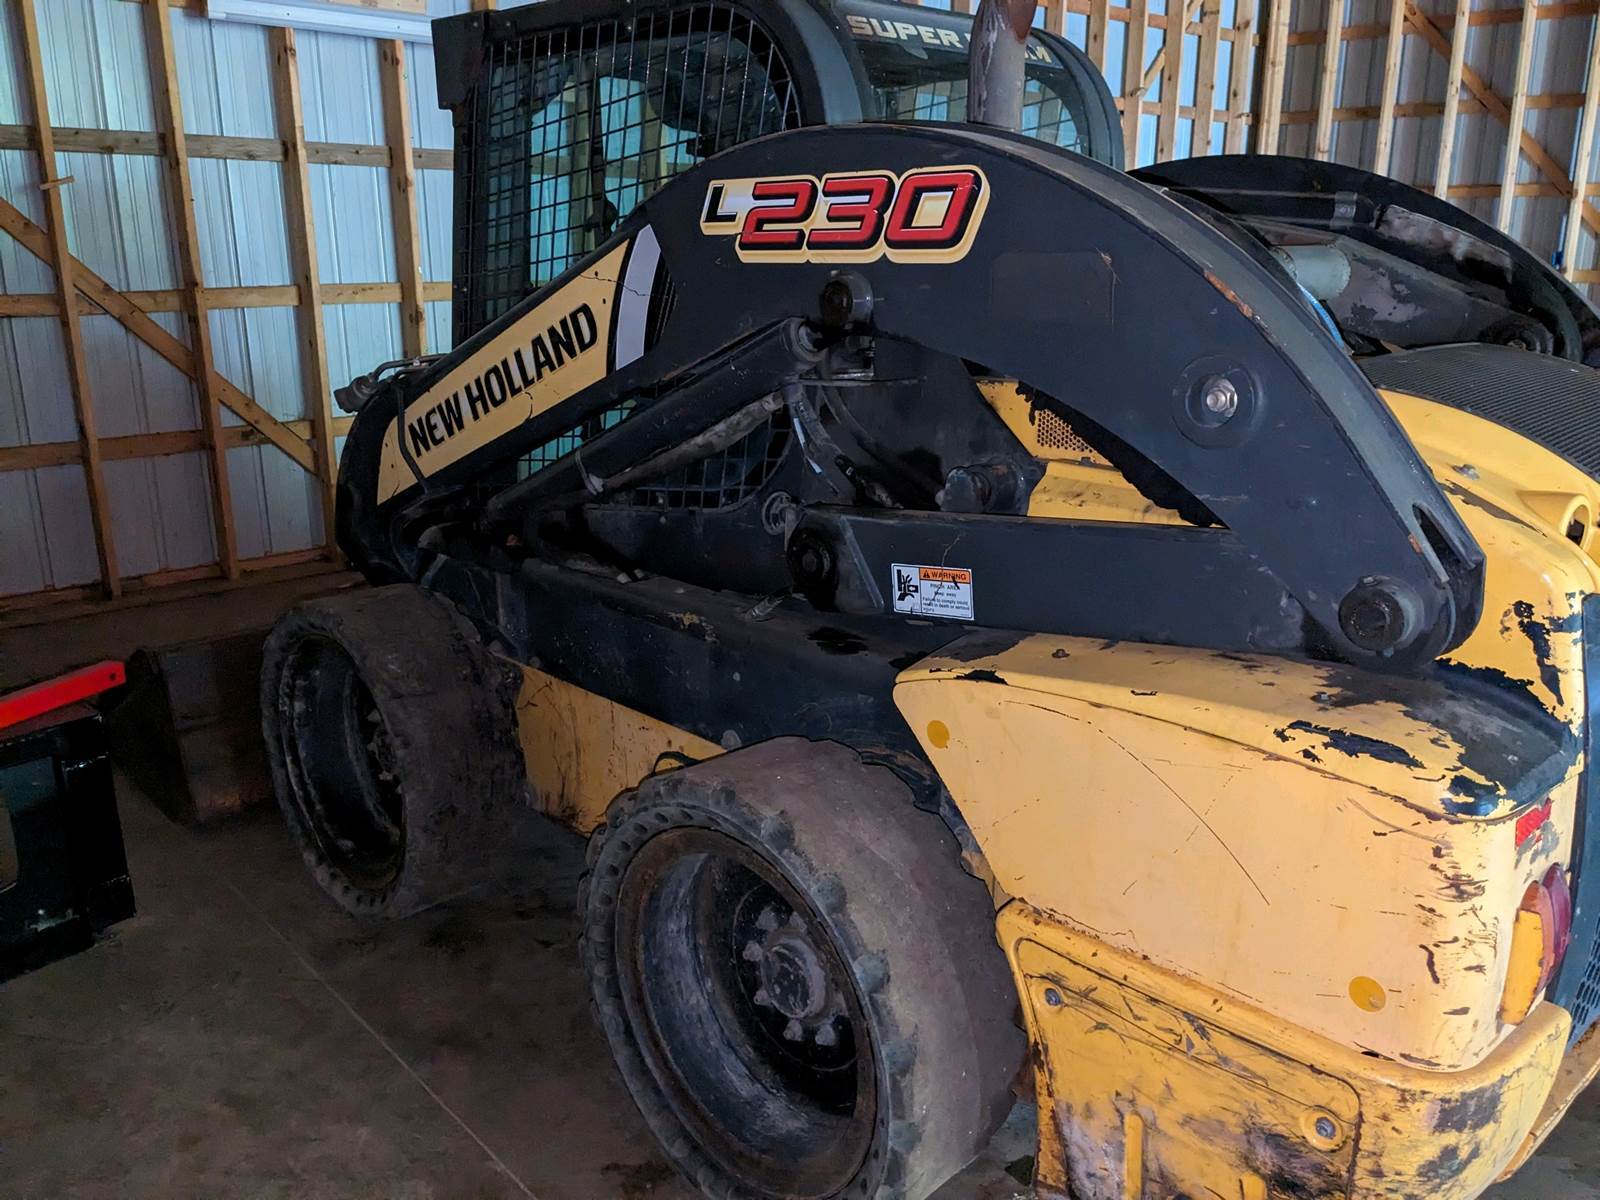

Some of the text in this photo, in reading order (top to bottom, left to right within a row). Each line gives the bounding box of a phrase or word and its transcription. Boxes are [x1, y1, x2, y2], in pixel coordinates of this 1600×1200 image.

[846, 15, 964, 48] SUPER
[703, 168, 985, 253] L230
[408, 302, 598, 458] NEW HOLLAND
[931, 571, 967, 581] WARNING
